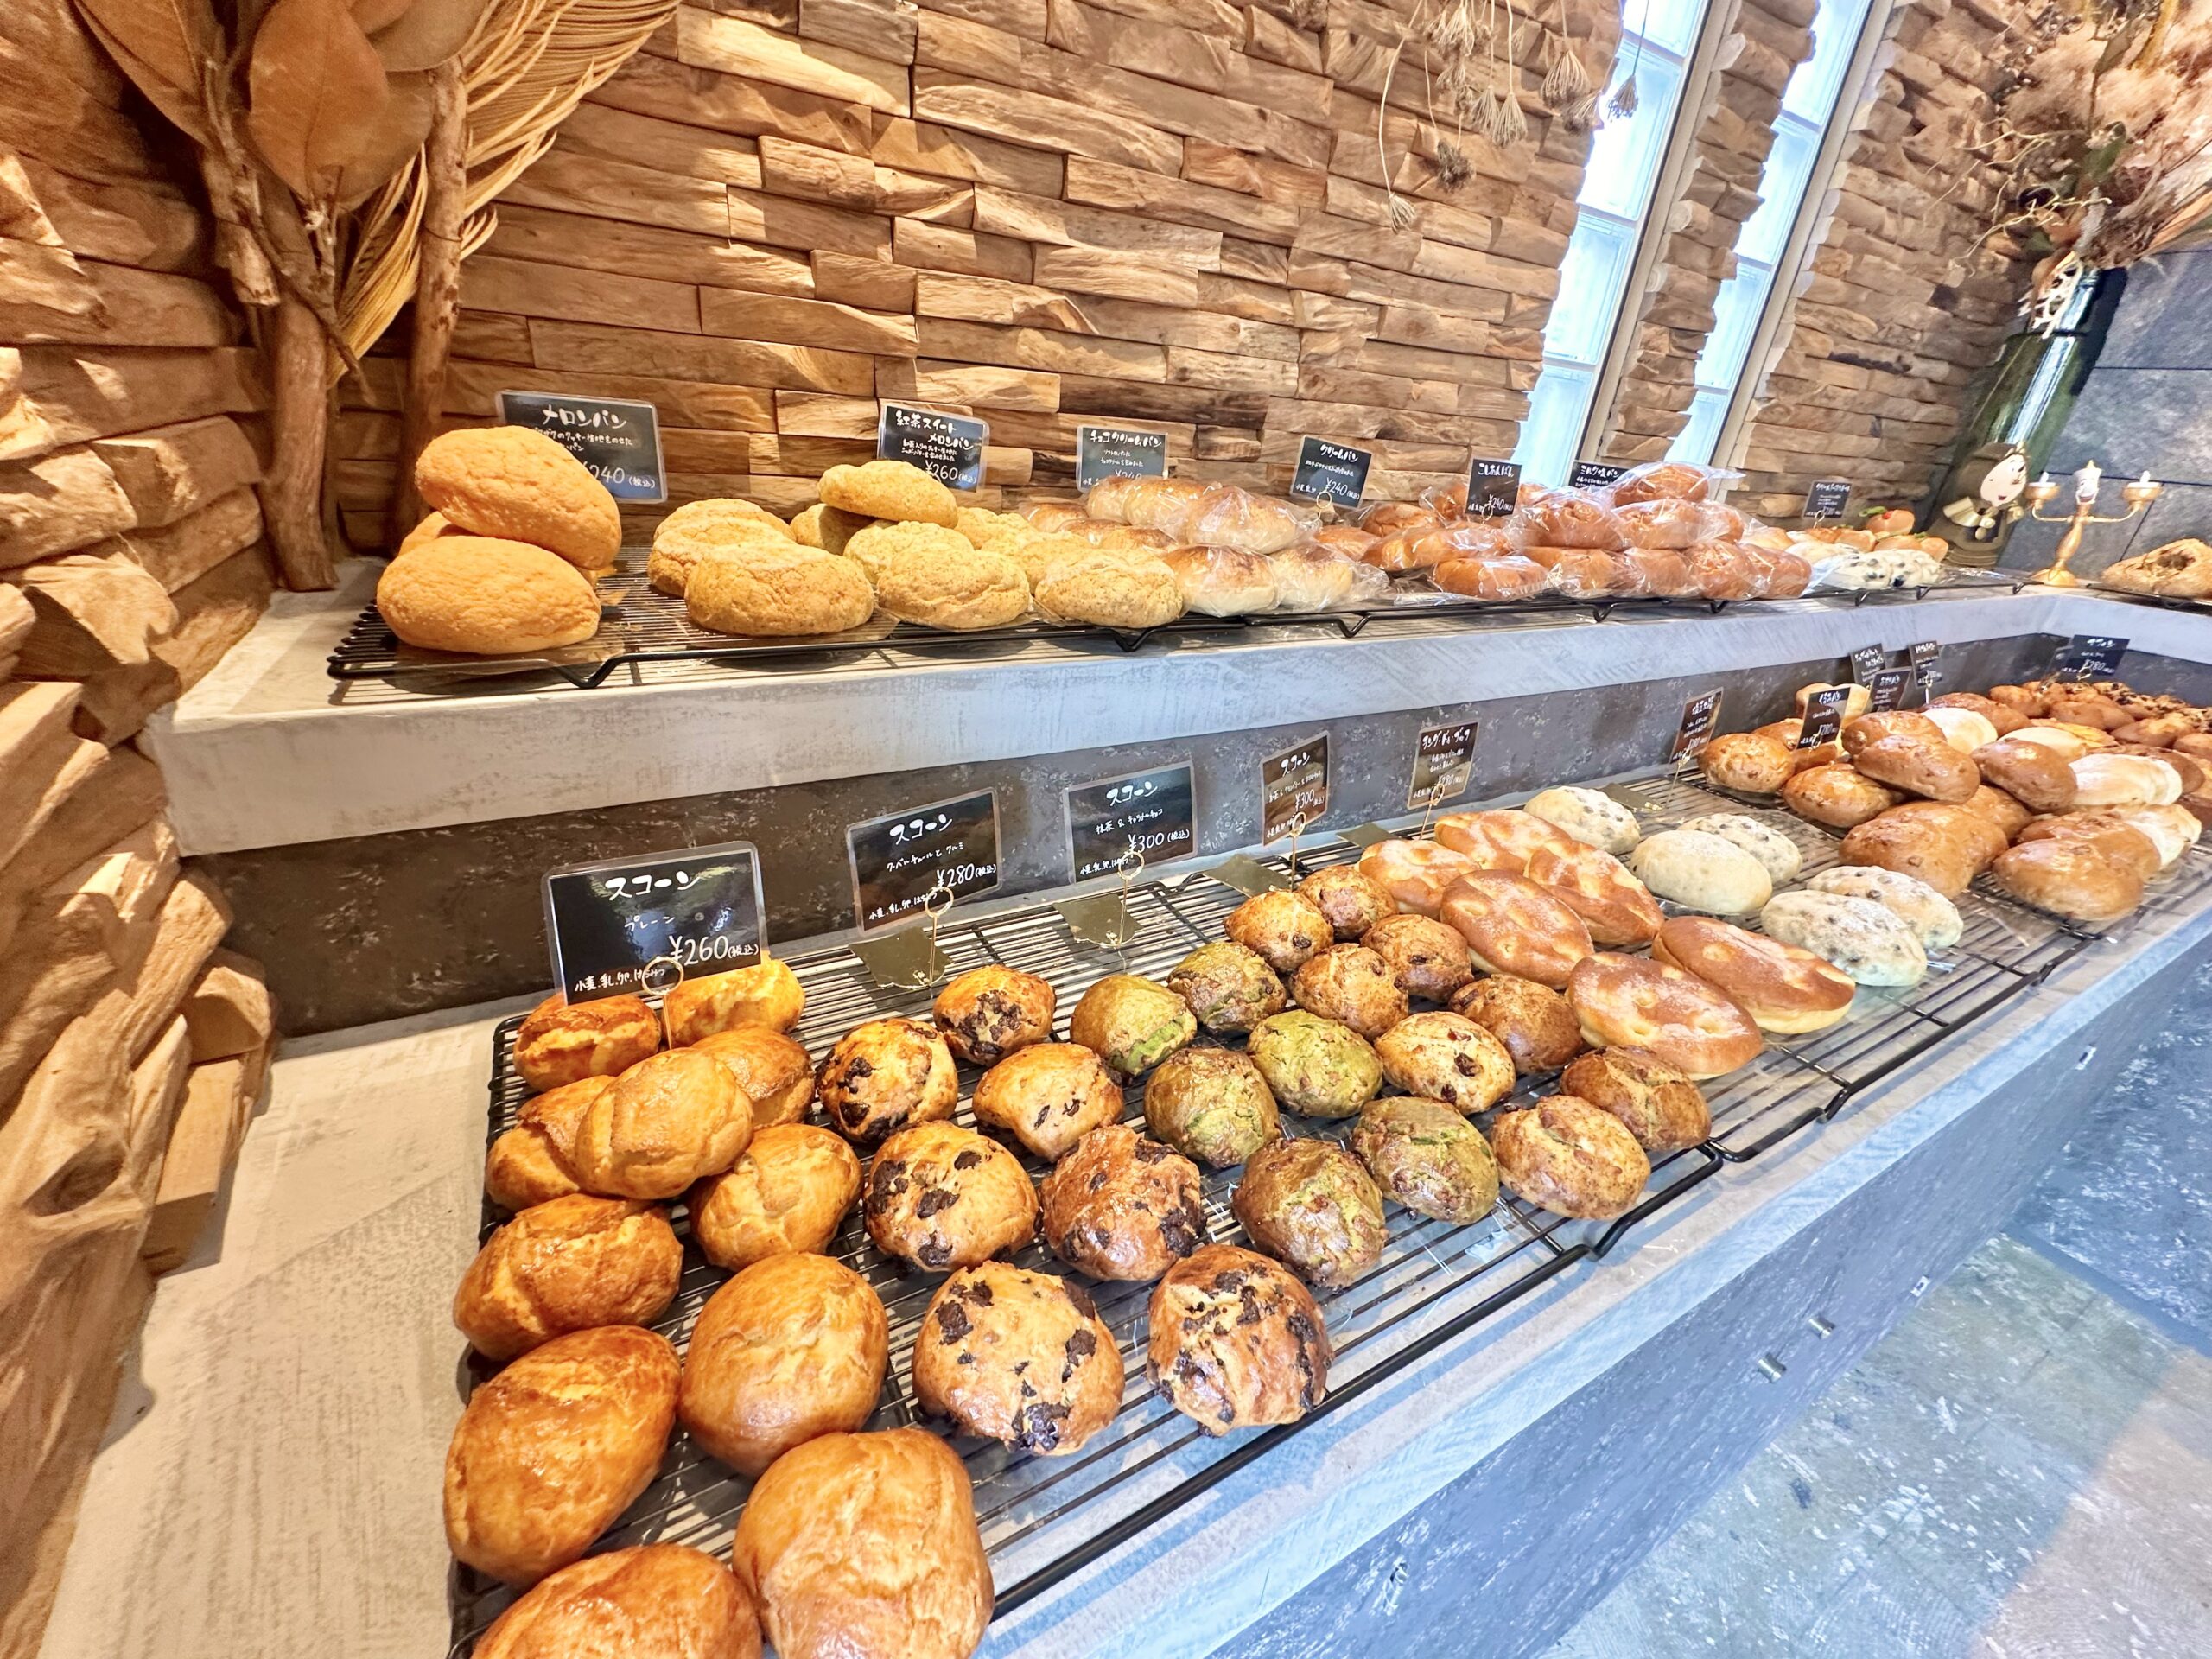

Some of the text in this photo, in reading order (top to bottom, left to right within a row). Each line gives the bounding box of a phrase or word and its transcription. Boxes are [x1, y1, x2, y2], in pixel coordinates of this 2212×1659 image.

[542, 404, 627, 429] メロンパン
[895, 410, 957, 434] 紅茶スイート
[927, 433, 975, 450] メロンパン
[1090, 429, 1162, 448] チョコクリームパン
[1320, 443, 1358, 463] クリームパン
[582, 461, 626, 485] 240
[925, 460, 958, 481] ¥260
[1325, 477, 1348, 496] ¥240
[1281, 752, 1310, 777] スコーン
[1106, 781, 1158, 807] スコーン
[1295, 788, 1314, 811] ¥300
[889, 813, 953, 845] スコーン
[1128, 832, 1165, 857] ¥300
[605, 870, 702, 901] スコーン
[936, 863, 975, 888] ¥280
[624, 915, 676, 931] プレーン
[667, 935, 760, 966] ¥260 (税込)
